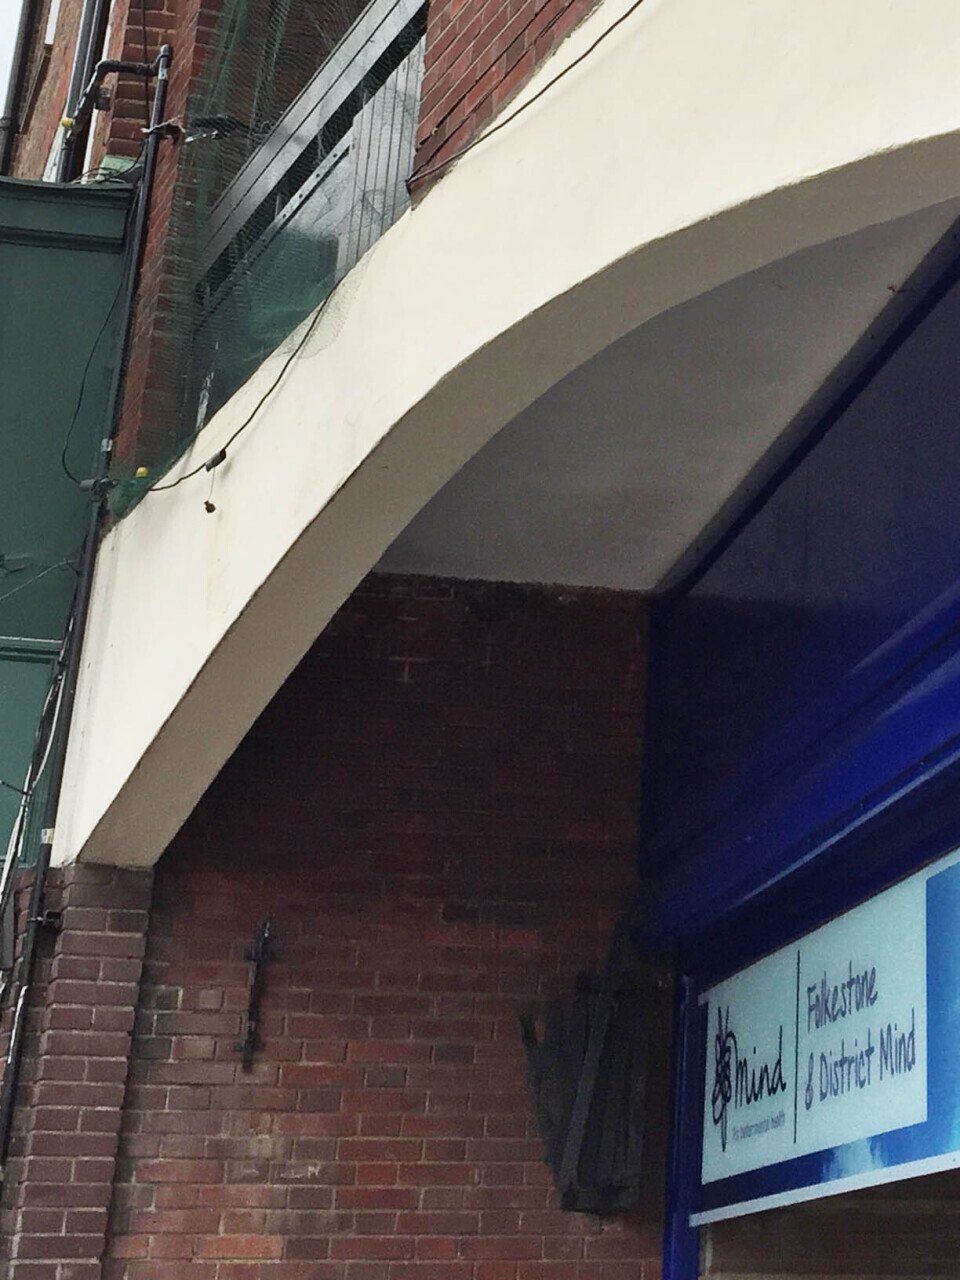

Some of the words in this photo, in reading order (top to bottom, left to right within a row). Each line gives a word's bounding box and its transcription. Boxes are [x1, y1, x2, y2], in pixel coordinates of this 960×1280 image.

[806, 960, 878, 1033] Folkestone
[734, 1025, 786, 1109] mind
[819, 1027, 875, 1102] District
[879, 1004, 916, 1081] Mind
